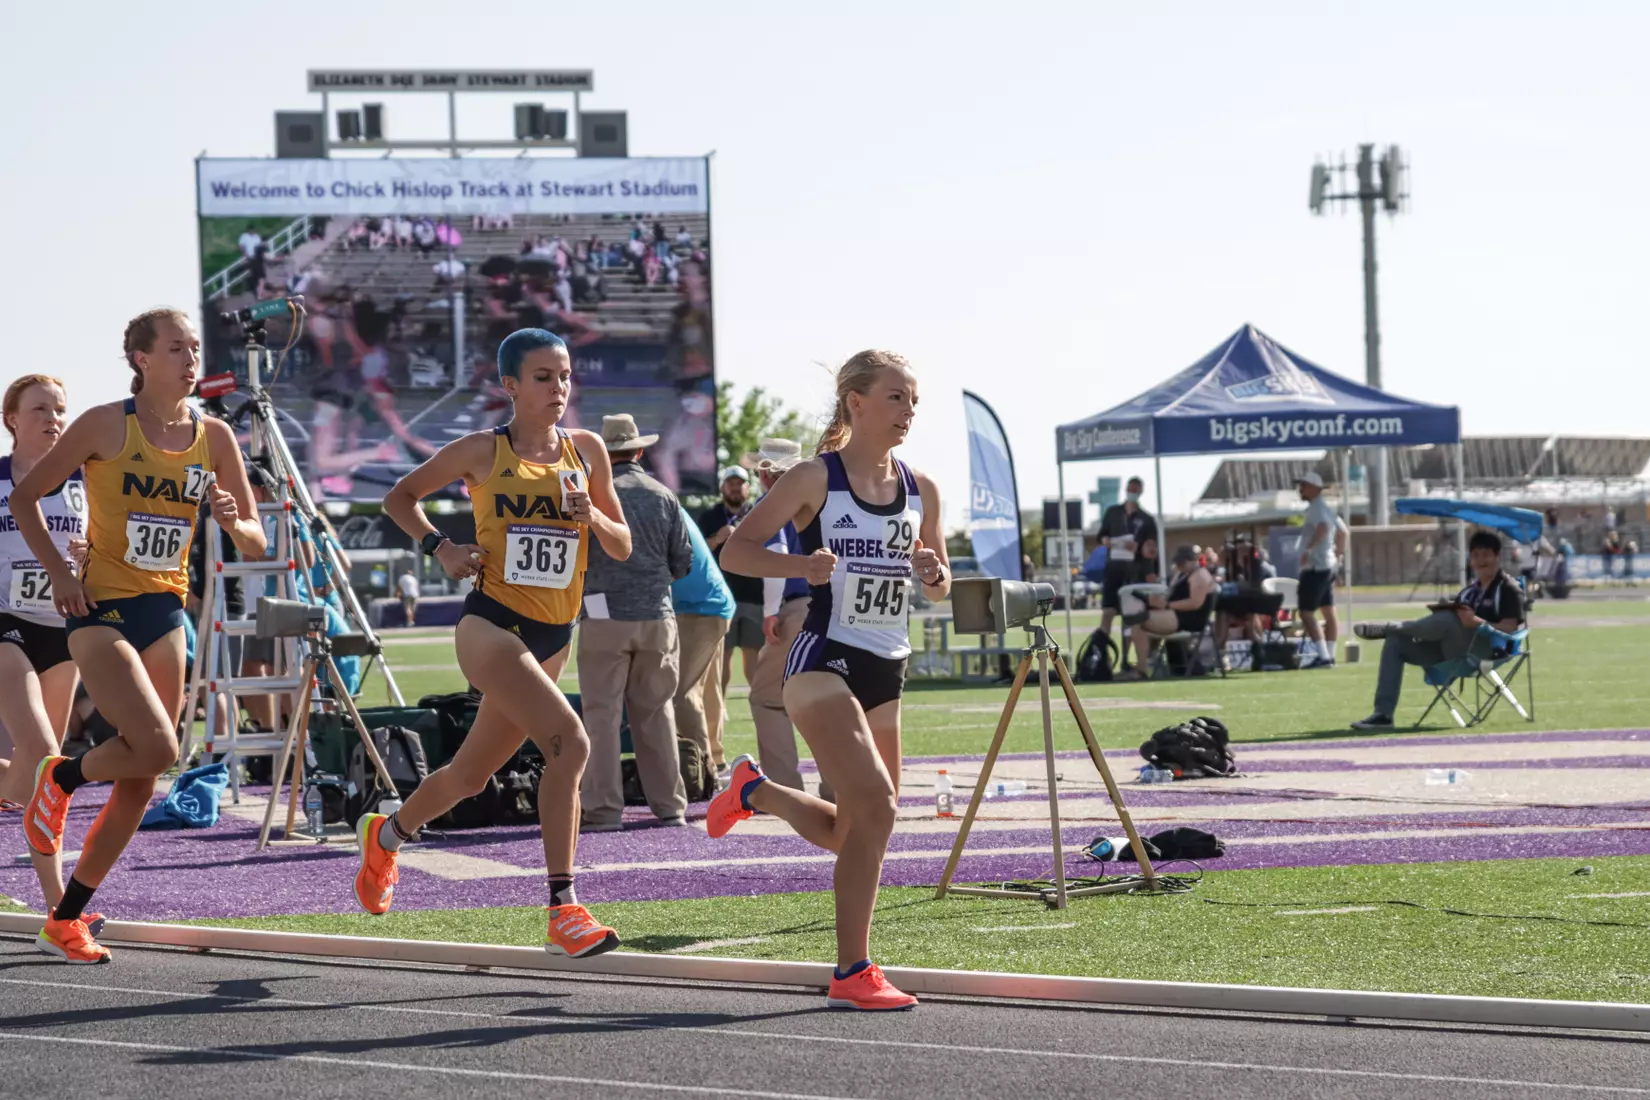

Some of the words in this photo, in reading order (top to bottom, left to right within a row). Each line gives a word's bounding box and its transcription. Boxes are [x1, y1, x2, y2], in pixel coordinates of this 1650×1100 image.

[467, 74, 527, 86] STEWART
[536, 74, 588, 86] STADIUM
[211, 181, 299, 198] Welcome
[306, 182, 325, 198] to
[330, 181, 385, 198] Chick
[392, 181, 453, 200] Hislop
[458, 181, 509, 197] Track
[515, 181, 533, 197] at
[540, 181, 614, 197] Stewart
[620, 180, 698, 197] Stadium
[1210, 414, 1403, 444] bigskyconf.com
[494, 494, 572, 521] NA
[46, 515, 83, 533] STATE
[887, 520, 912, 551] 29
[135, 525, 181, 558] 366
[517, 536, 567, 574] 363
[828, 538, 884, 558] WEBER
[21, 571, 52, 600] 52
[855, 577, 904, 616] 545
